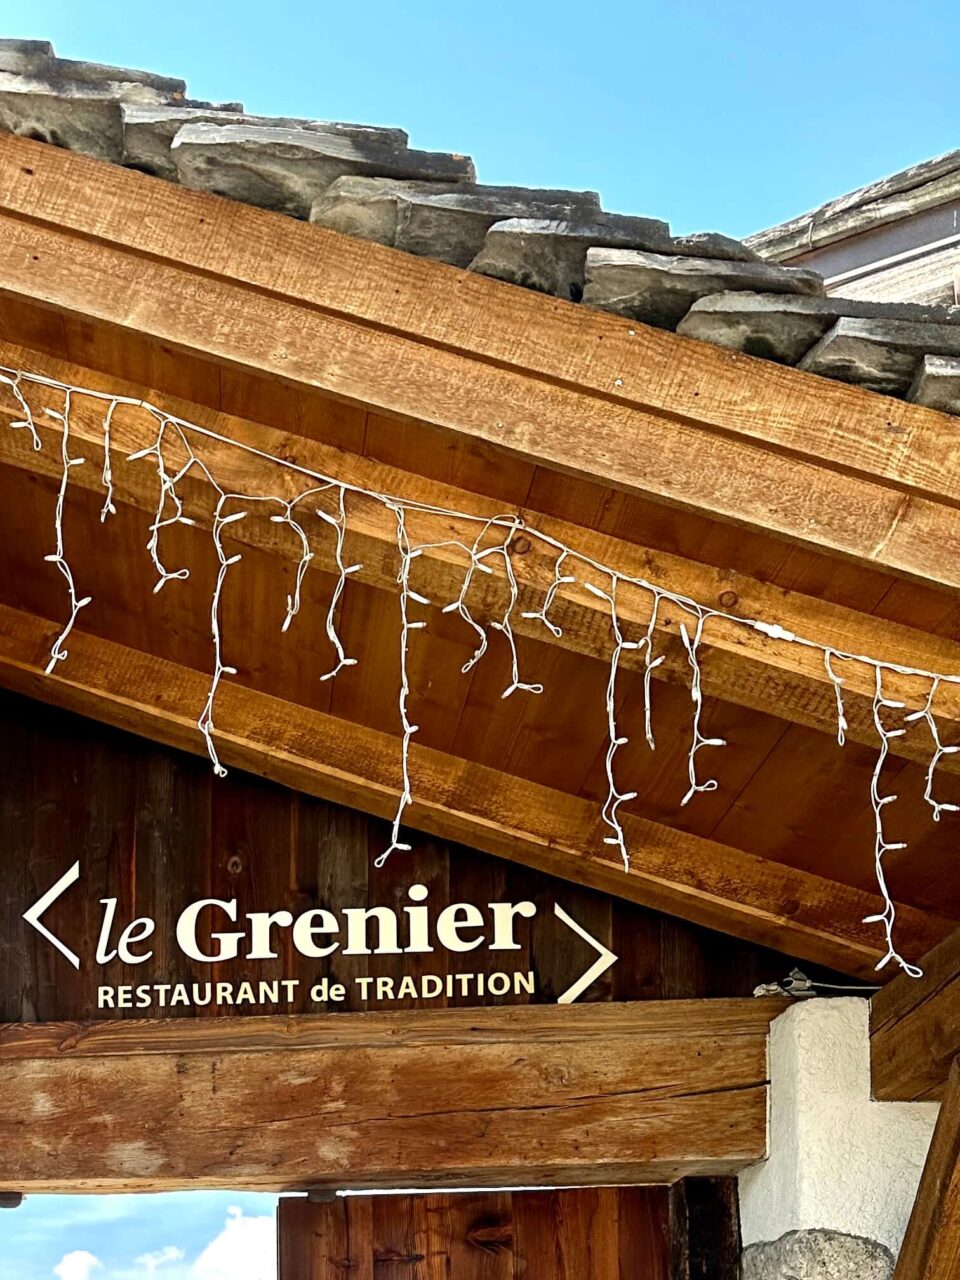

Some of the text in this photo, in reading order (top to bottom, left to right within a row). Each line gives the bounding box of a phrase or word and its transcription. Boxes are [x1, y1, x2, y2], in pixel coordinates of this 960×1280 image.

[95, 884, 537, 965] le Grenier
[97, 970, 536, 1008] RESTAURANT de TRADITION
